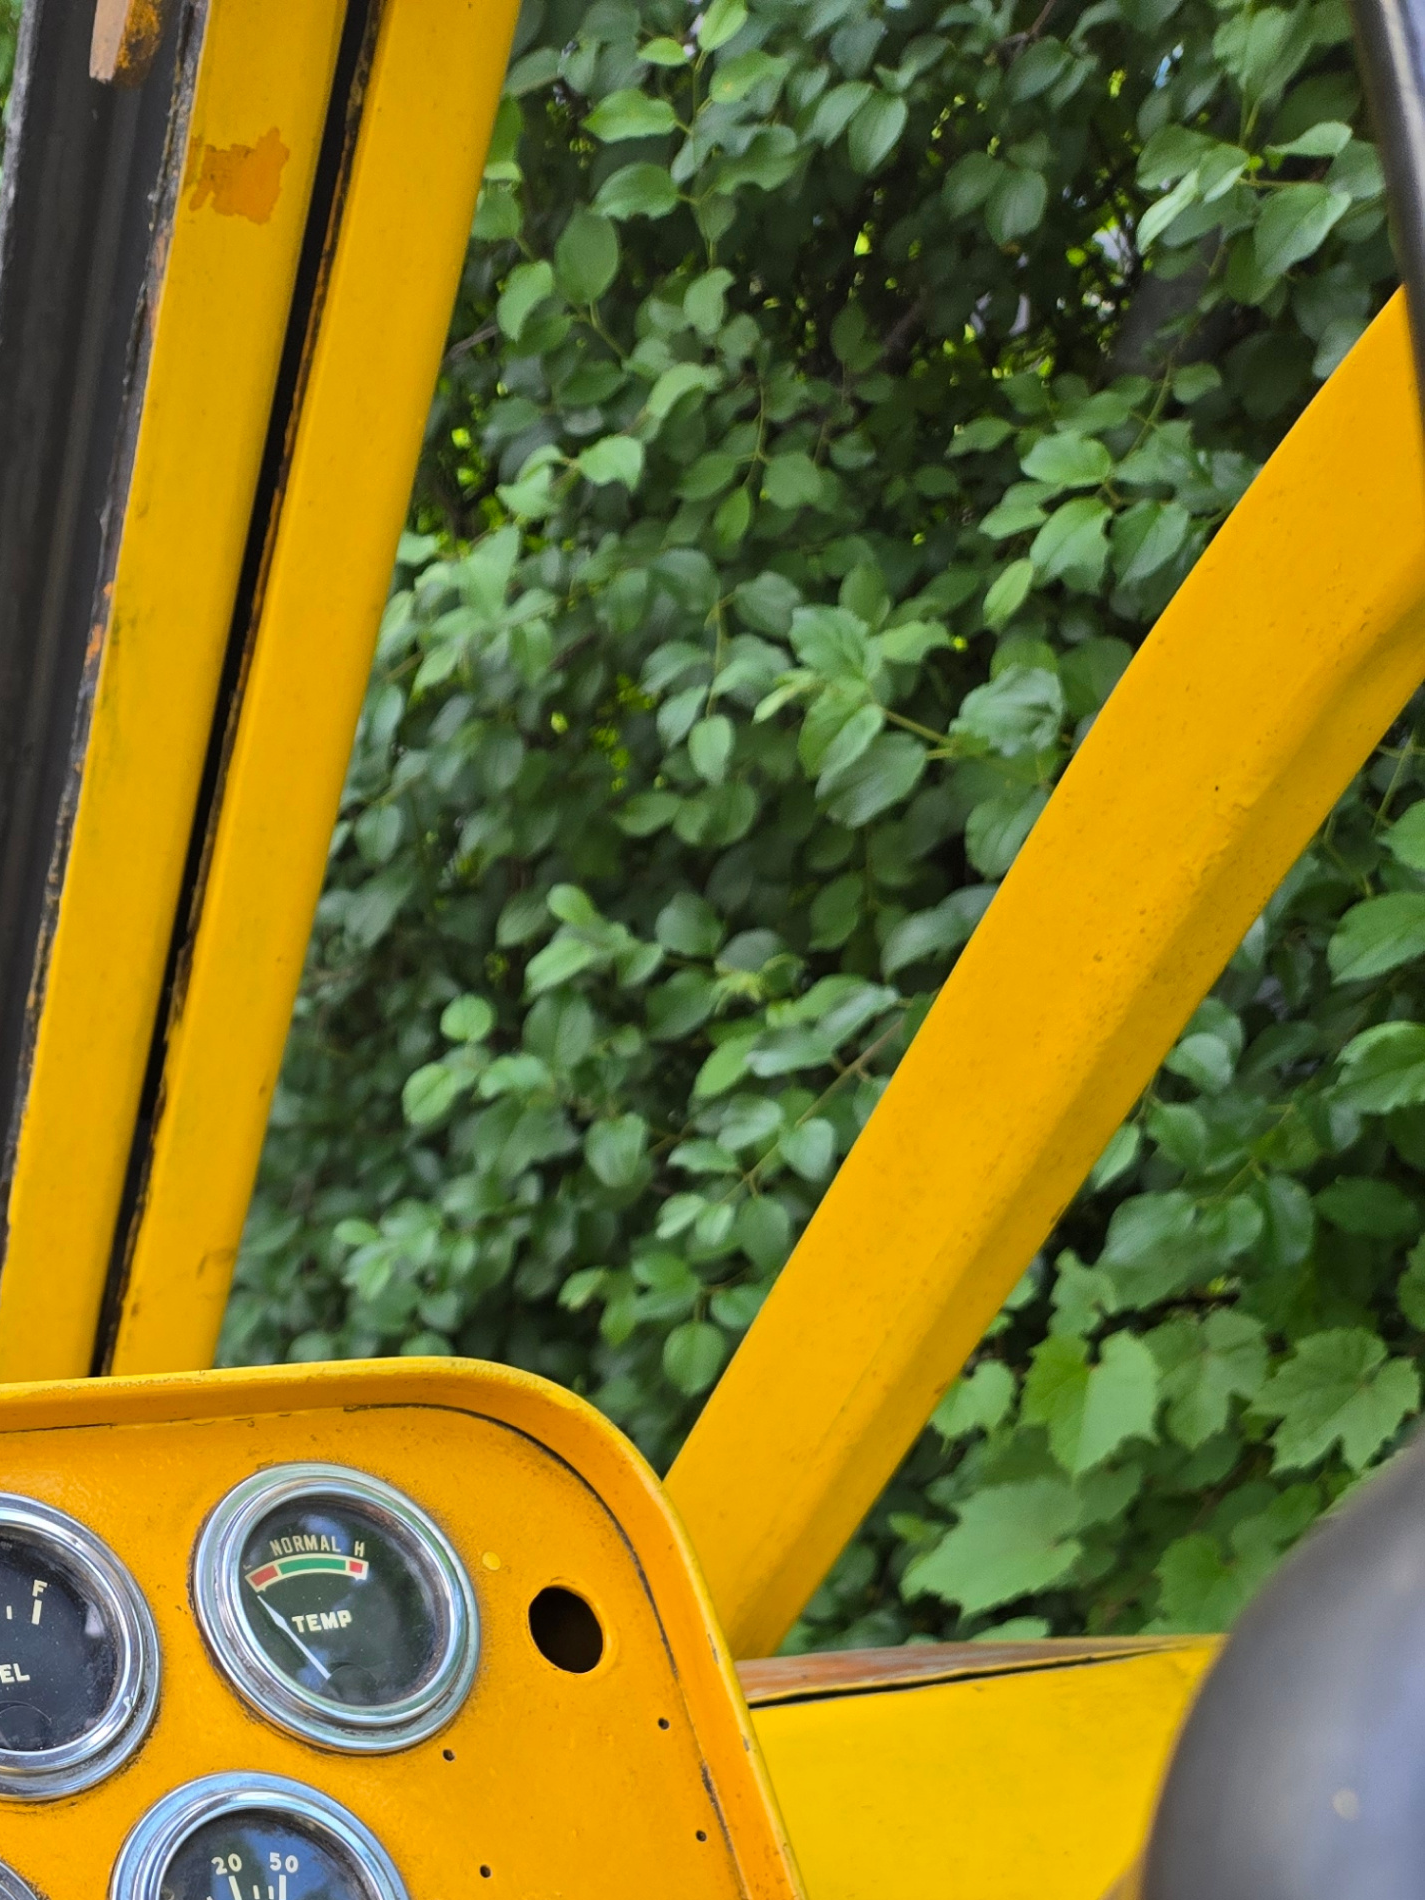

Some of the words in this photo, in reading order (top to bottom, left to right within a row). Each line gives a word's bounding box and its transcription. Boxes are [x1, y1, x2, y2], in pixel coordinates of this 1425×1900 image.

[269, 1534, 341, 1556] NORMAL
[354, 1541, 365, 1557] H
[32, 1579, 48, 1597] F
[292, 1610, 352, 1634] TEMP
[211, 1853, 242, 1875] 20
[269, 1852, 299, 1873] 50
